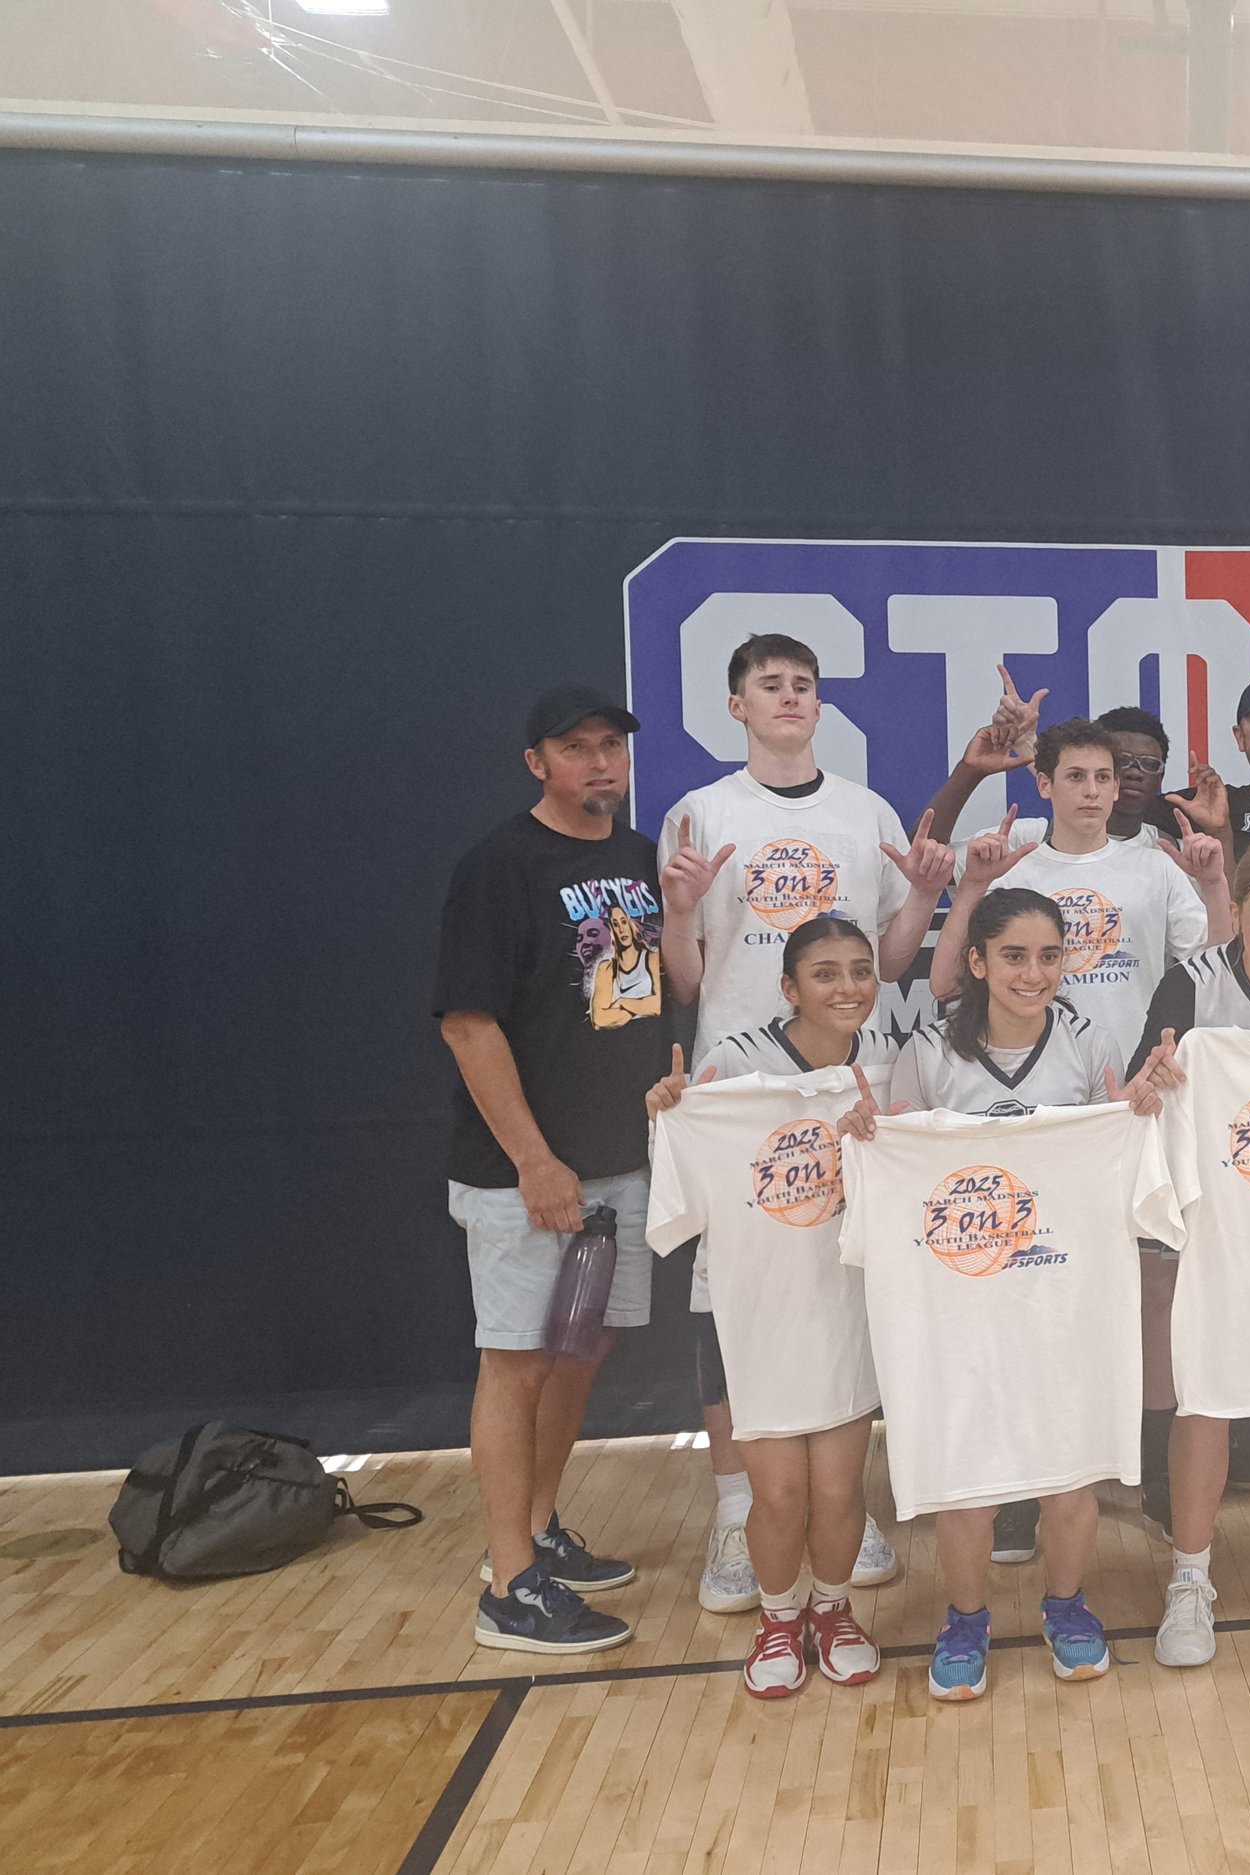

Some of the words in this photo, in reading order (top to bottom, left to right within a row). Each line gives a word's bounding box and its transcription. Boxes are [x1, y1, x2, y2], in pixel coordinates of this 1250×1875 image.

[767, 848, 810, 864] 2025
[744, 862, 786, 870] MARCH
[747, 870, 765, 896] 3
[775, 875, 811, 893] on
[817, 870, 836, 894] 3
[737, 896, 779, 904] YOUTH
[782, 893, 851, 902] BASKETBALL
[1056, 895, 1095, 910] 2025
[1101, 913, 1118, 937] 3
[1061, 971, 1130, 985] AMPION
[773, 1126, 821, 1153] 2025
[750, 1151, 795, 1168] MARCH
[757, 1165, 775, 1197] 3
[785, 1161, 826, 1187] on
[950, 1175, 1003, 1196] 2025
[923, 1196, 971, 1207] MARCH
[976, 1190, 1040, 1202] MADNESS
[927, 1206, 948, 1237] 3
[959, 1210, 1002, 1233] on
[1011, 1198, 1033, 1229] 3
[913, 1236, 963, 1247] YOUTH
[968, 1227, 1054, 1241] BASKETBALL
[957, 1239, 1013, 1251] LEAGUE
[1002, 1253, 1069, 1269] JPSPORTS
